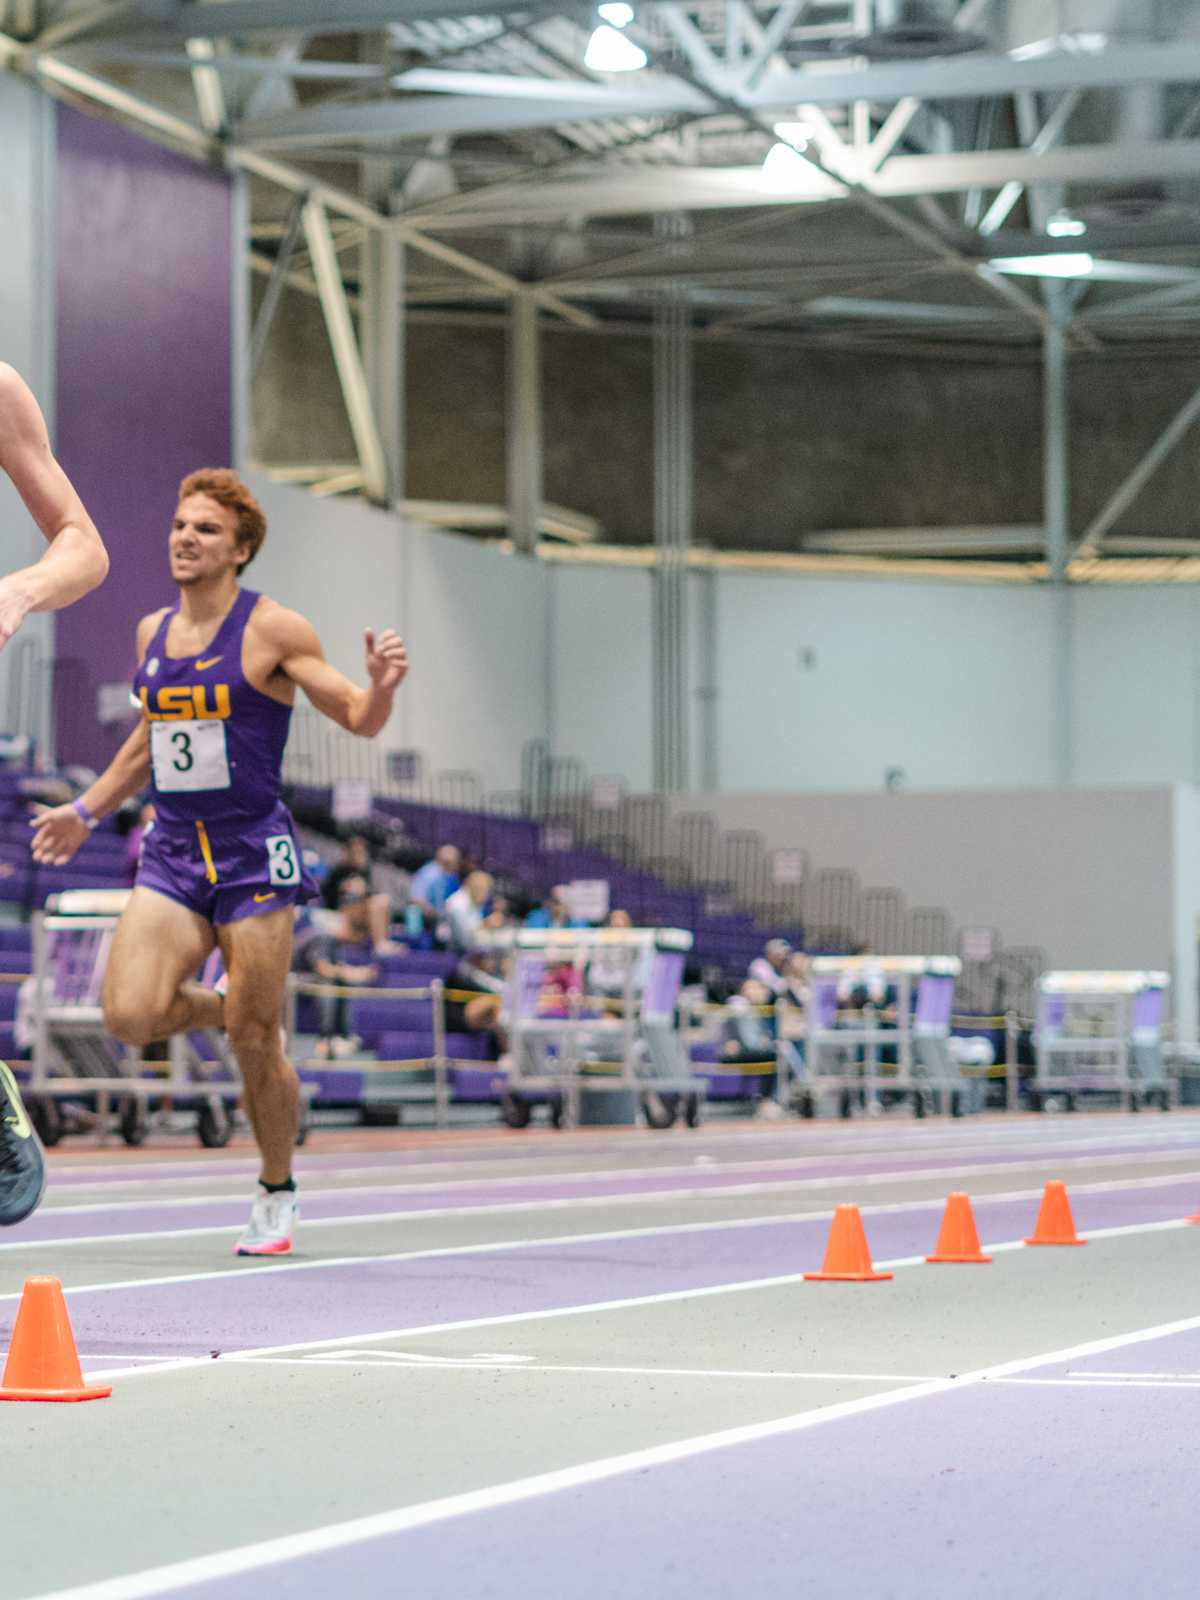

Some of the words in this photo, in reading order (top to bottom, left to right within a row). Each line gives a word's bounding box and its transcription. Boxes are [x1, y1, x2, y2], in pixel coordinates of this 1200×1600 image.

[140, 684, 232, 720] LSU
[171, 731, 193, 772] 3
[274, 840, 294, 880] 3
